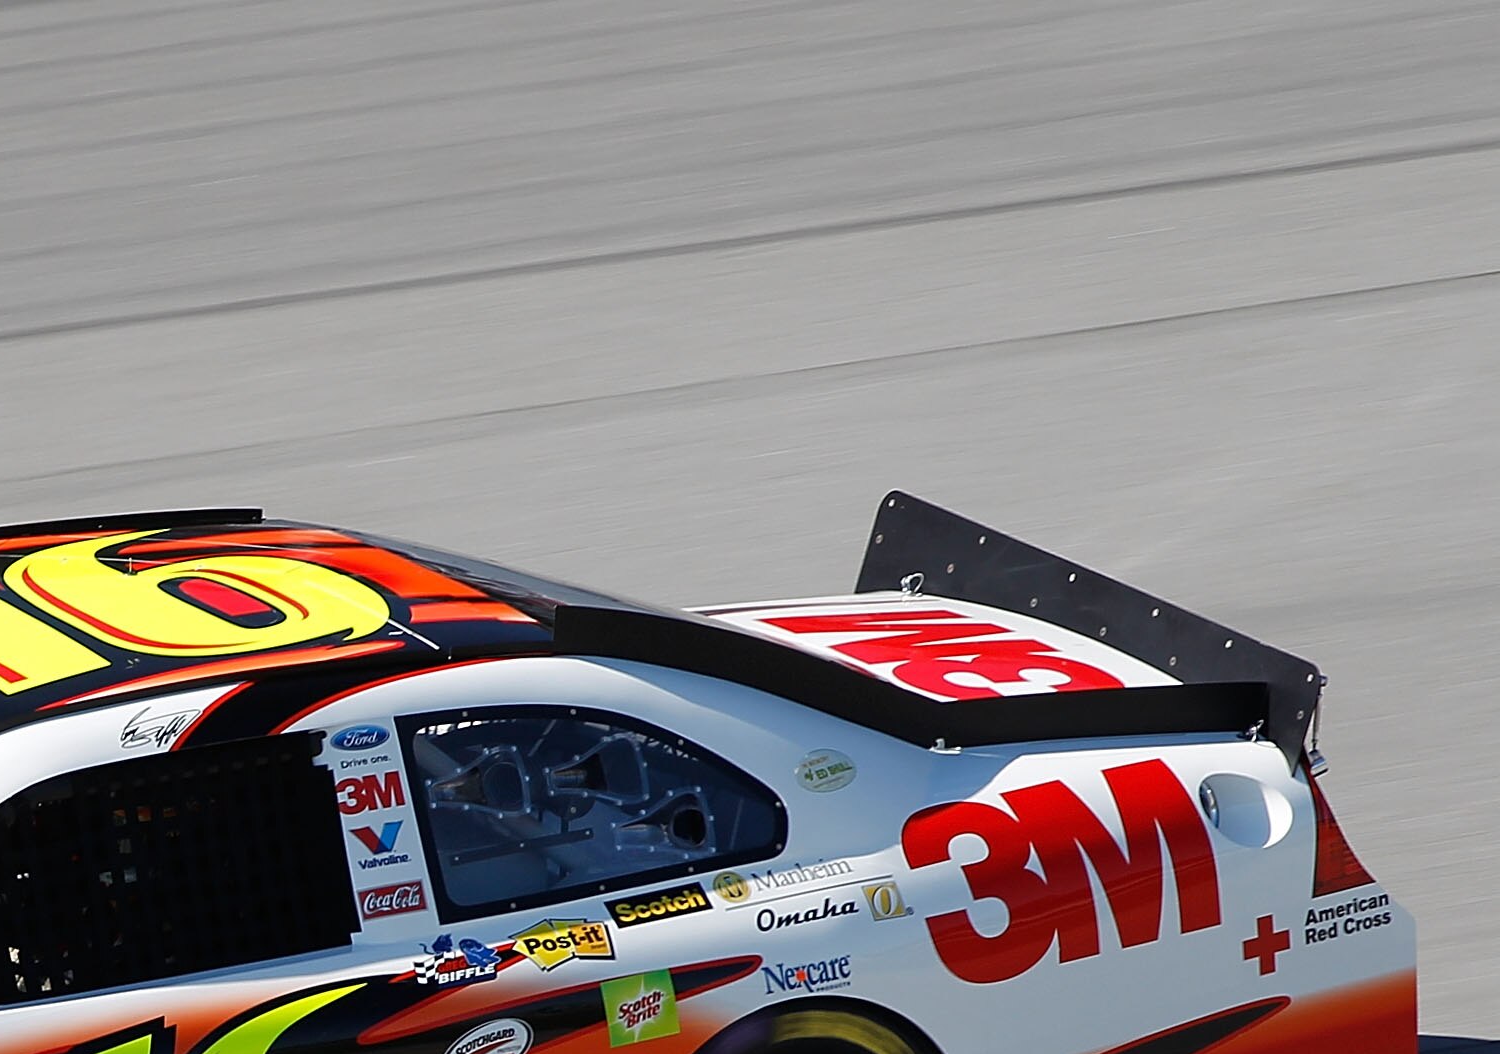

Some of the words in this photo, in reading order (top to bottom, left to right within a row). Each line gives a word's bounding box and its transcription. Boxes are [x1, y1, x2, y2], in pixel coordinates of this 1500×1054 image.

[343, 729, 379, 747] Ford
[341, 758, 368, 769] Drive
[336, 771, 406, 815] 3M
[751, 857, 853, 892] Manheim
[901, 758, 1221, 985] 3M
[363, 884, 421, 914] Coca-Cola
[615, 887, 707, 922] Scotch
[757, 898, 860, 932] Omaha
[1305, 893, 1390, 927] American
[524, 924, 603, 954] Post-it
[1305, 922, 1338, 945] Red
[1343, 911, 1393, 936] Cross
[437, 958, 467, 973] GREG
[437, 963, 496, 984] BIFFLE
[761, 955, 851, 995] Nexcare
[815, 981, 851, 992] PRODUCTS
[626, 1004, 661, 1029] Brite
